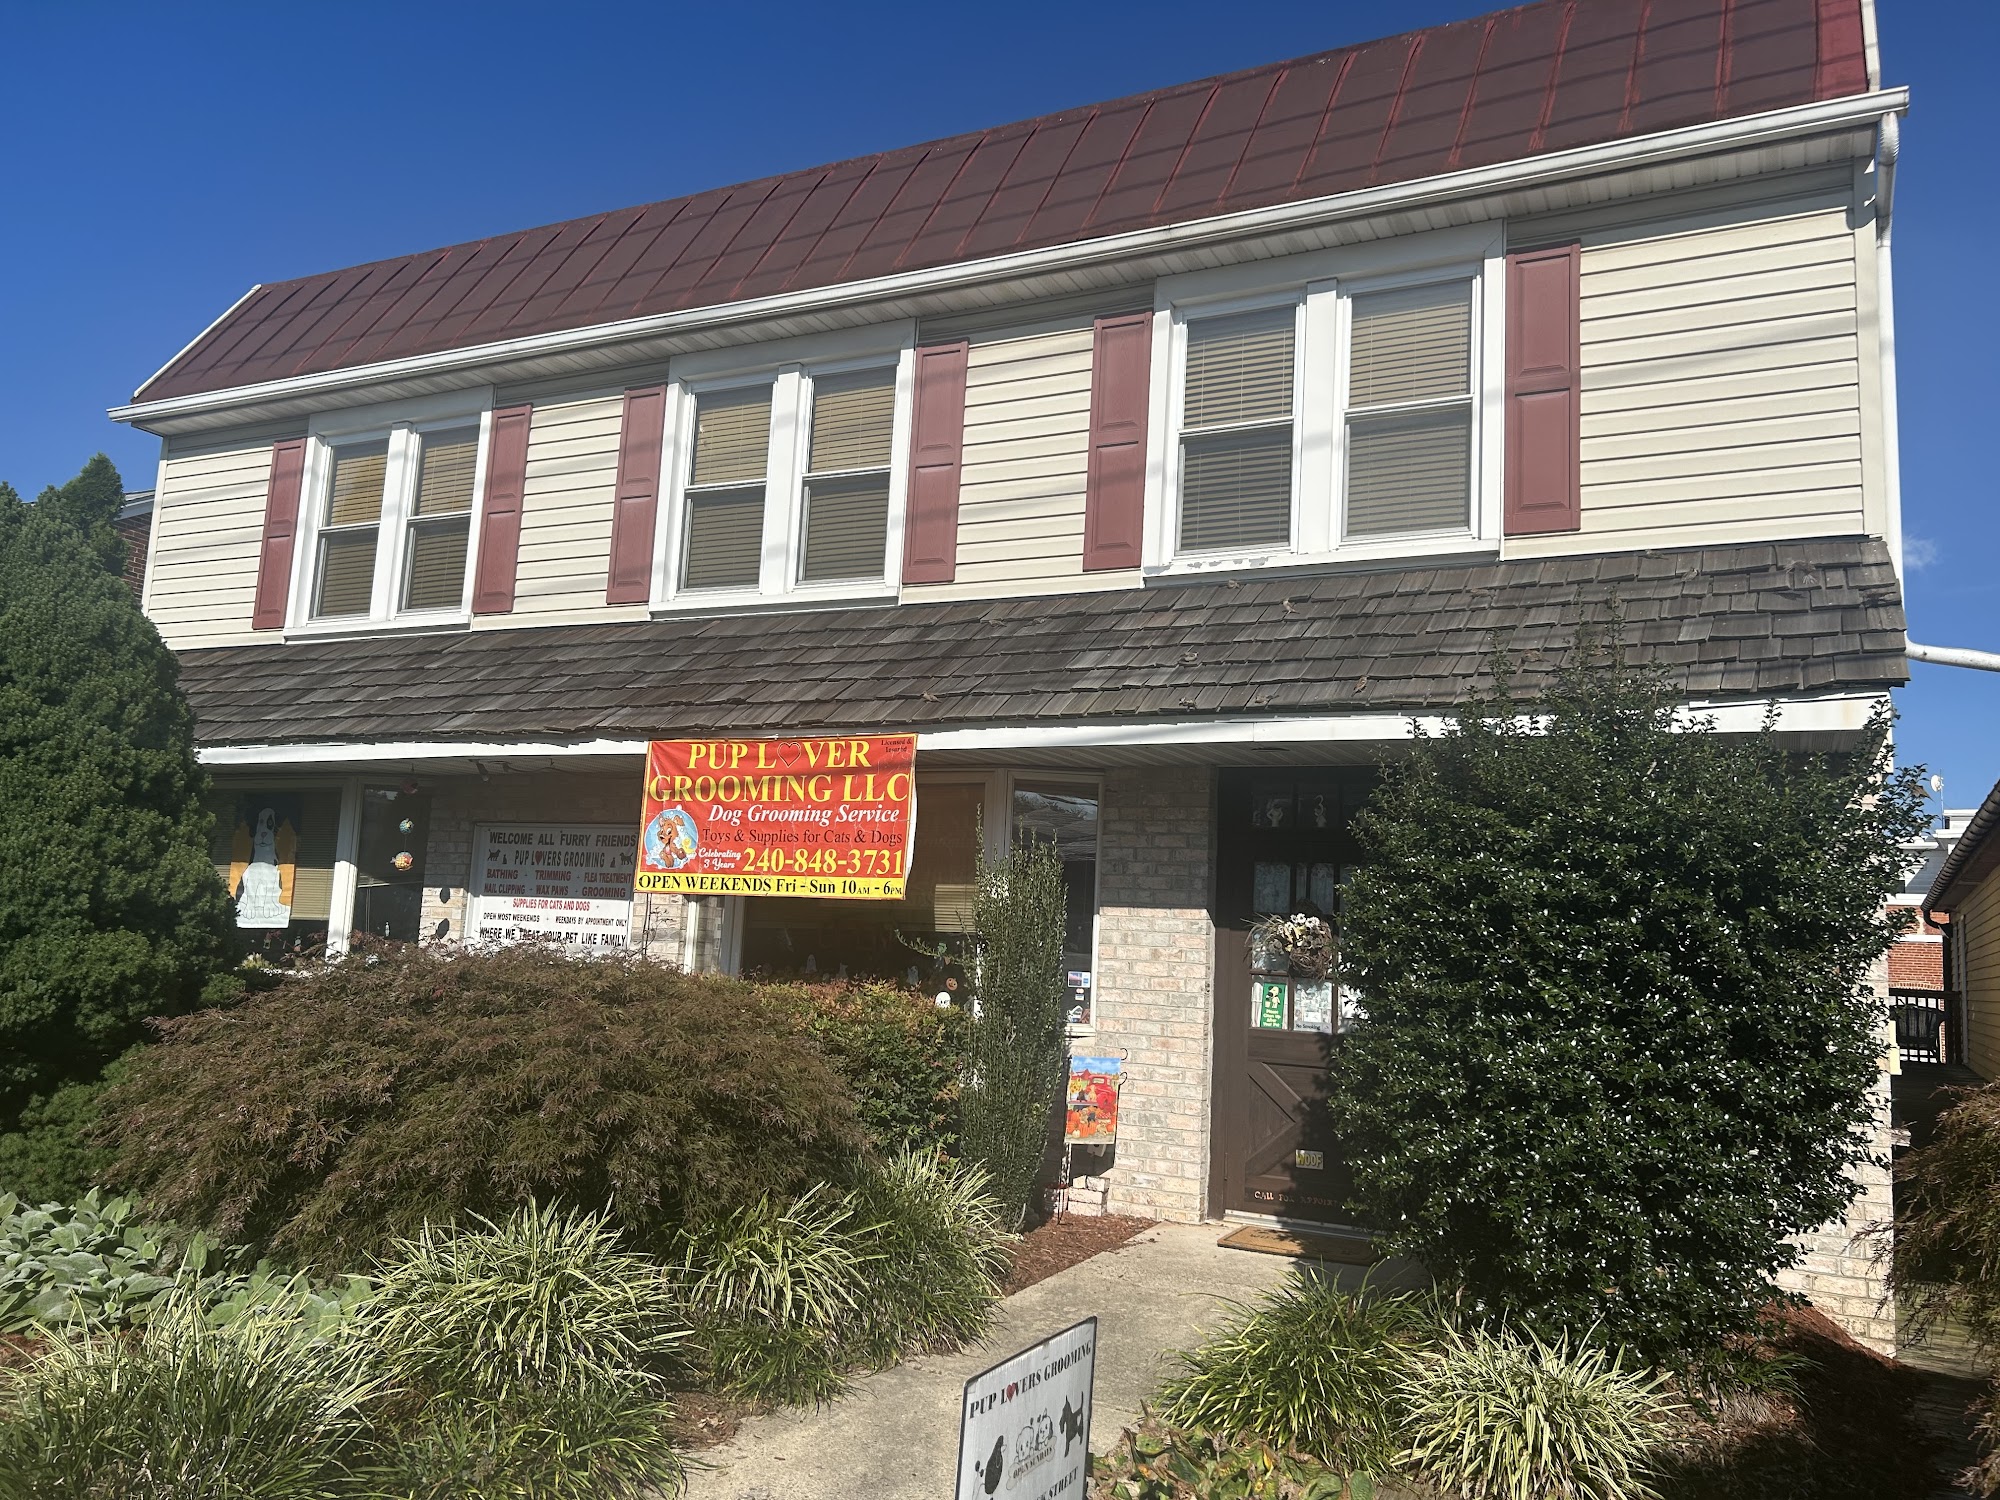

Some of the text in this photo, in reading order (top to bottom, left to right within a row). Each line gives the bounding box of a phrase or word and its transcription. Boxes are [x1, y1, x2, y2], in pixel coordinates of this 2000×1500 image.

[687, 743, 748, 769] PUP
[650, 772, 910, 802] GROOMING LLC
[708, 804, 900, 827] Dog Grooming Service
[489, 831, 636, 847] WELCOME ALL FURRY FRIENDS
[703, 828, 902, 846] Toys & Supplies for Cats & Dogs
[514, 850, 529, 865] PUP
[564, 851, 605, 868] GROOMING
[698, 847, 741, 860] Celebrating
[742, 847, 902, 875] 240-848-3731
[704, 858, 735, 871] 3 Years
[486, 868, 632, 885] BATHING TRIMMING FLEA TREATMENT
[638, 875, 681, 889] OPEN
[685, 876, 772, 892] WEEKENDS
[776, 878, 797, 893] Fri
[809, 879, 836, 894] Sun
[841, 880, 870, 895] 10AM
[883, 880, 902, 895] 6PM
[484, 883, 626, 898] NAIL CLIPPING WAX PAWS GROOMING
[513, 898, 590, 911] SUPPLIES FOR CATS AND DOGS
[483, 912, 496, 920] OPEN
[497, 913, 511, 921] MOST
[512, 914, 540, 923] WEEKENDS
[555, 916, 576, 925] WEEKDAYS
[585, 917, 614, 926] APPOINTMENT
[505, 928, 515, 940] WE
[566, 932, 578, 943] PET
[582, 933, 597, 944] LIKE
[601, 934, 626, 947] FAMILY
[1297, 1153, 1322, 1167] WOOF
[1255, 1191, 1274, 1200] CALL
[969, 1392, 997, 1420] PUP
[1044, 1340, 1091, 1381] GROOMING
[1048, 1466, 1078, 1500] STREET
